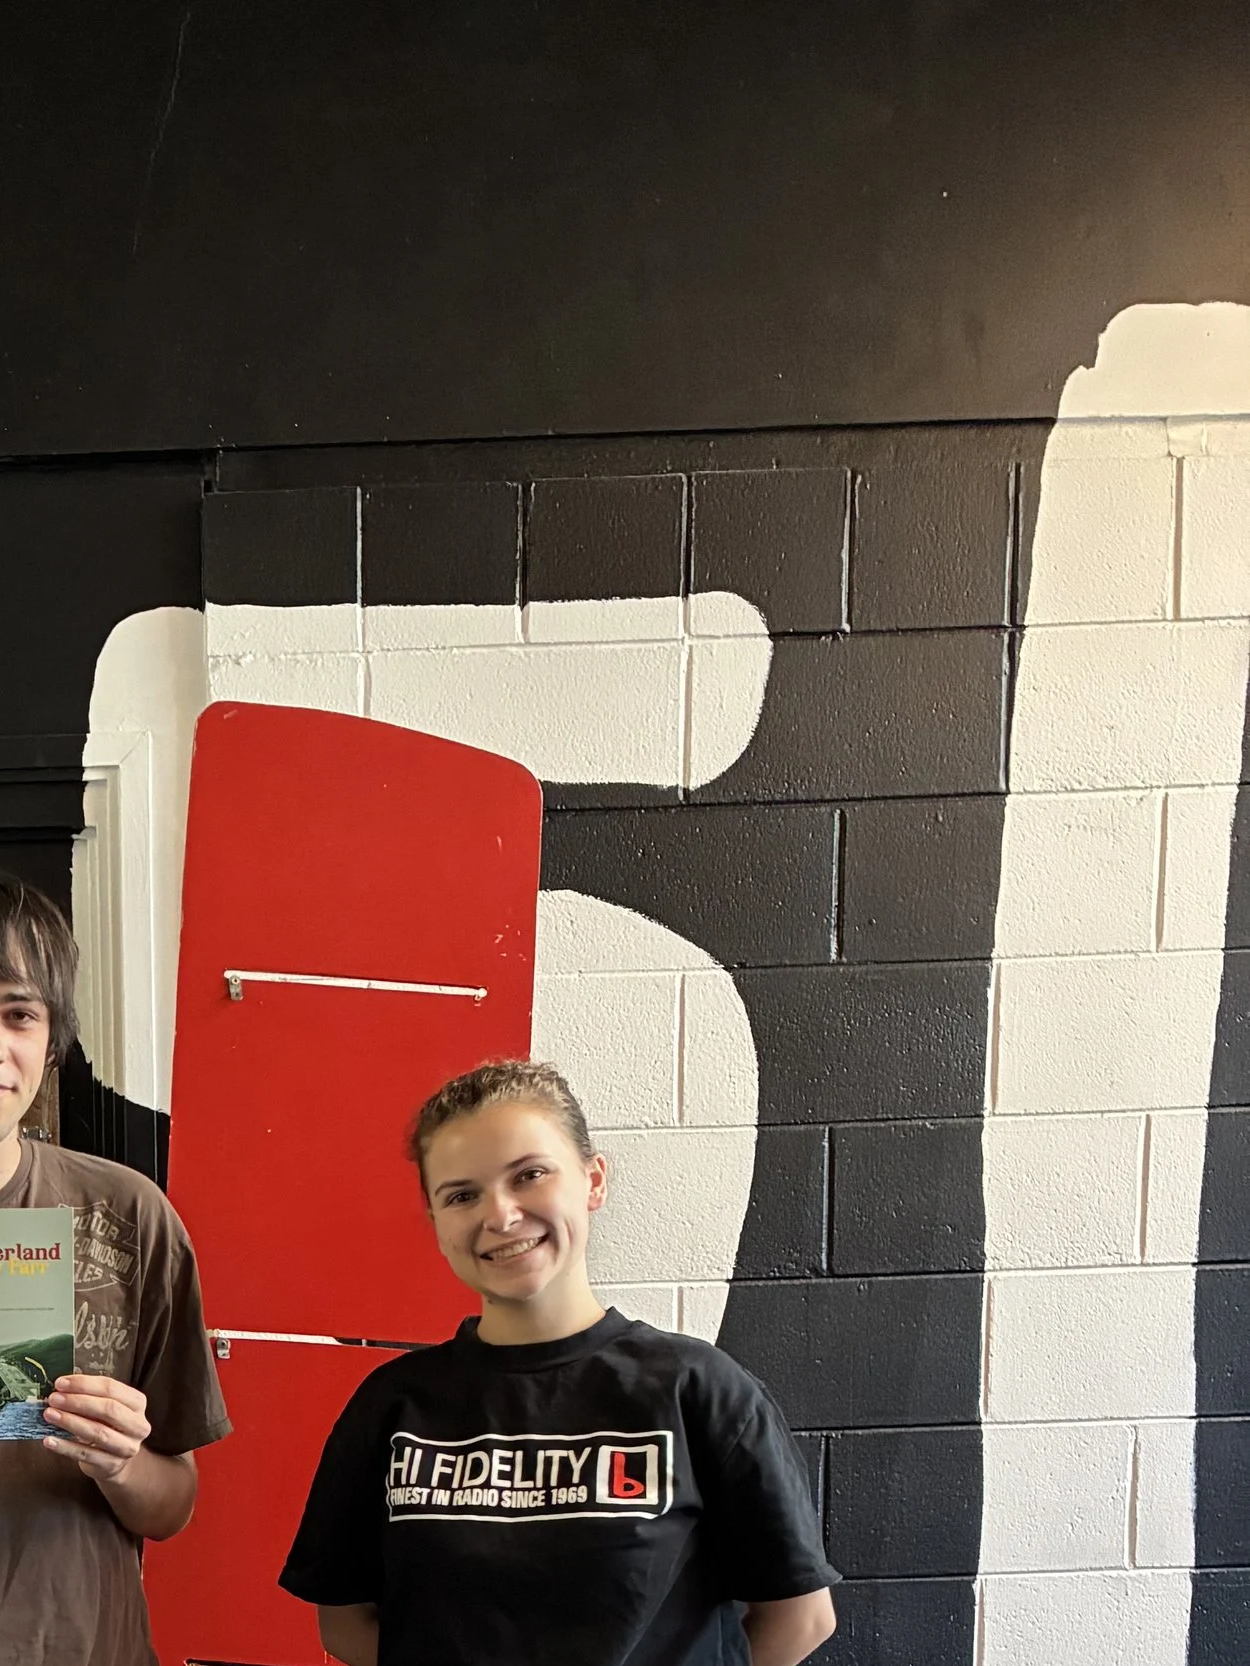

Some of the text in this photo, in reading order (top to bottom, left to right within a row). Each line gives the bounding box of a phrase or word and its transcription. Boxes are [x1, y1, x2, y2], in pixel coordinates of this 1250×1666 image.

[8, 1257, 48, 1277] Farr
[74, 1237, 135, 1274] -DAVIDSON
[390, 1447, 592, 1489] HI FIDELITY
[611, 1451, 645, 1498] b
[390, 1485, 588, 1509] FINEST IN RADIO SINCE 1969
